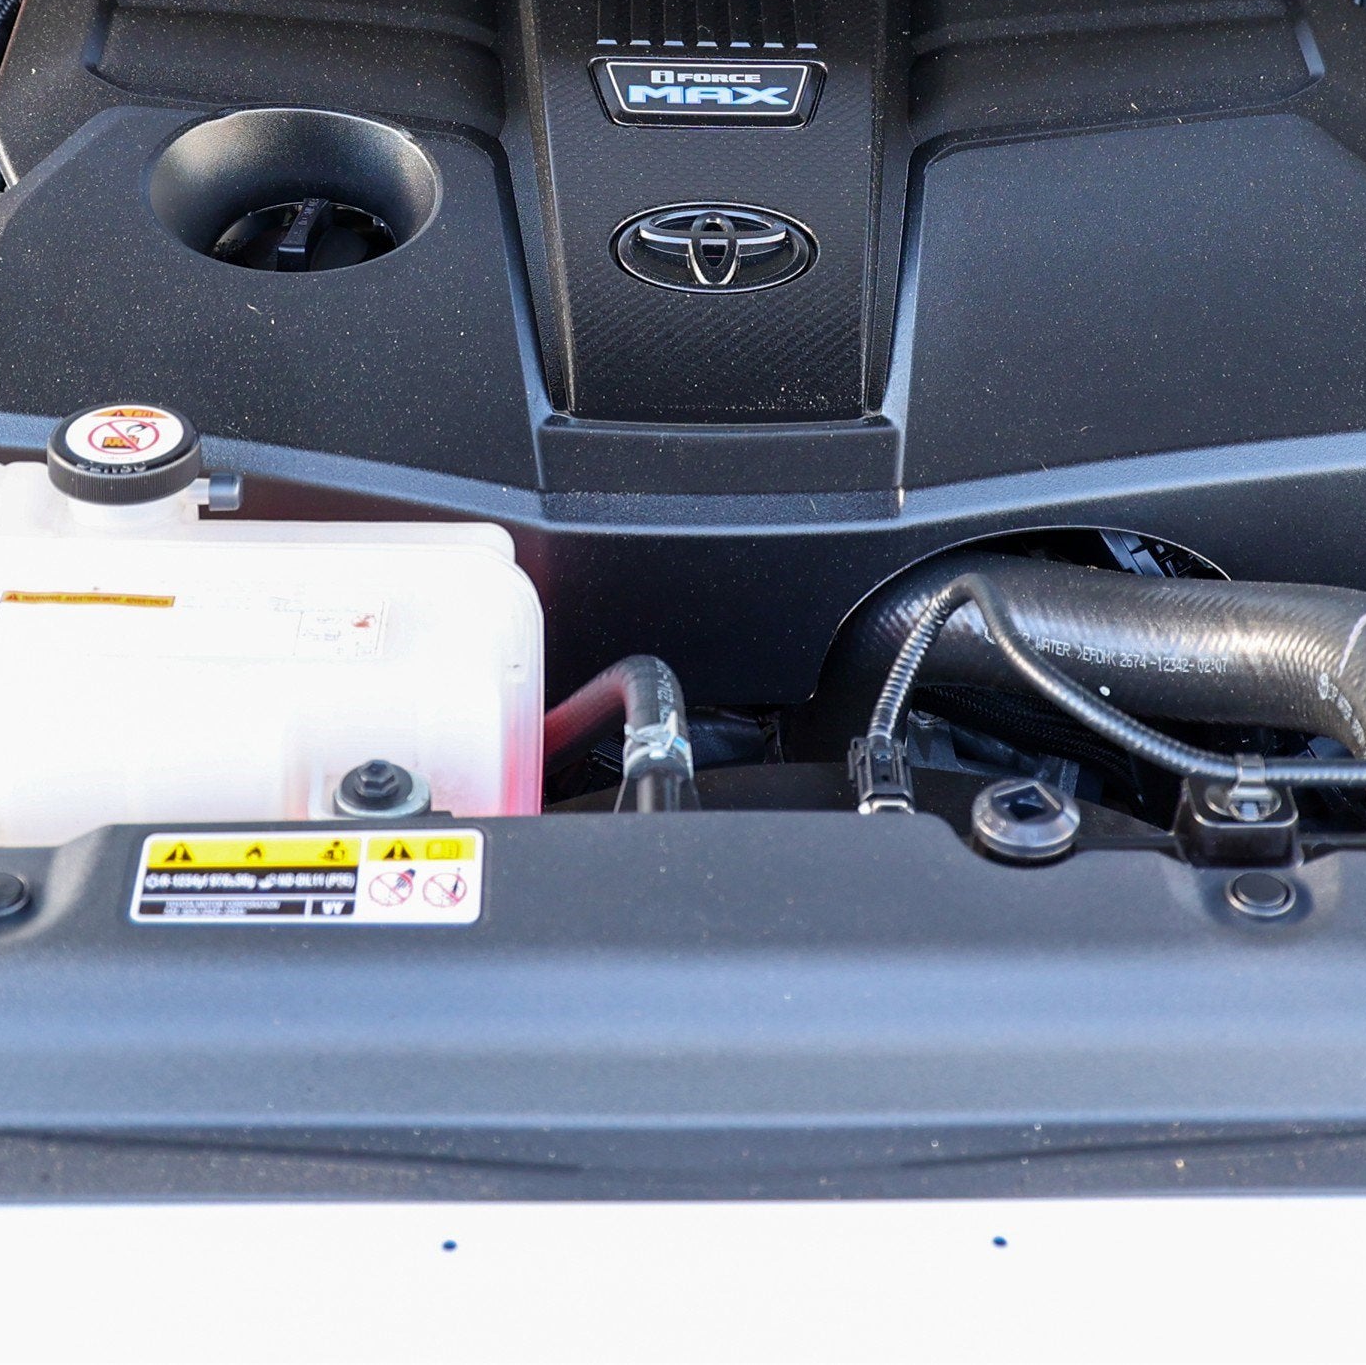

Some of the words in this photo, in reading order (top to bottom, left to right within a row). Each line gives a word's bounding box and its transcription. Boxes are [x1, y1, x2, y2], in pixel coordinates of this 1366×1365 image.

[677, 73, 762, 84] FORCE
[628, 85, 790, 105] MAX
[1035, 636, 1071, 658] WATER
